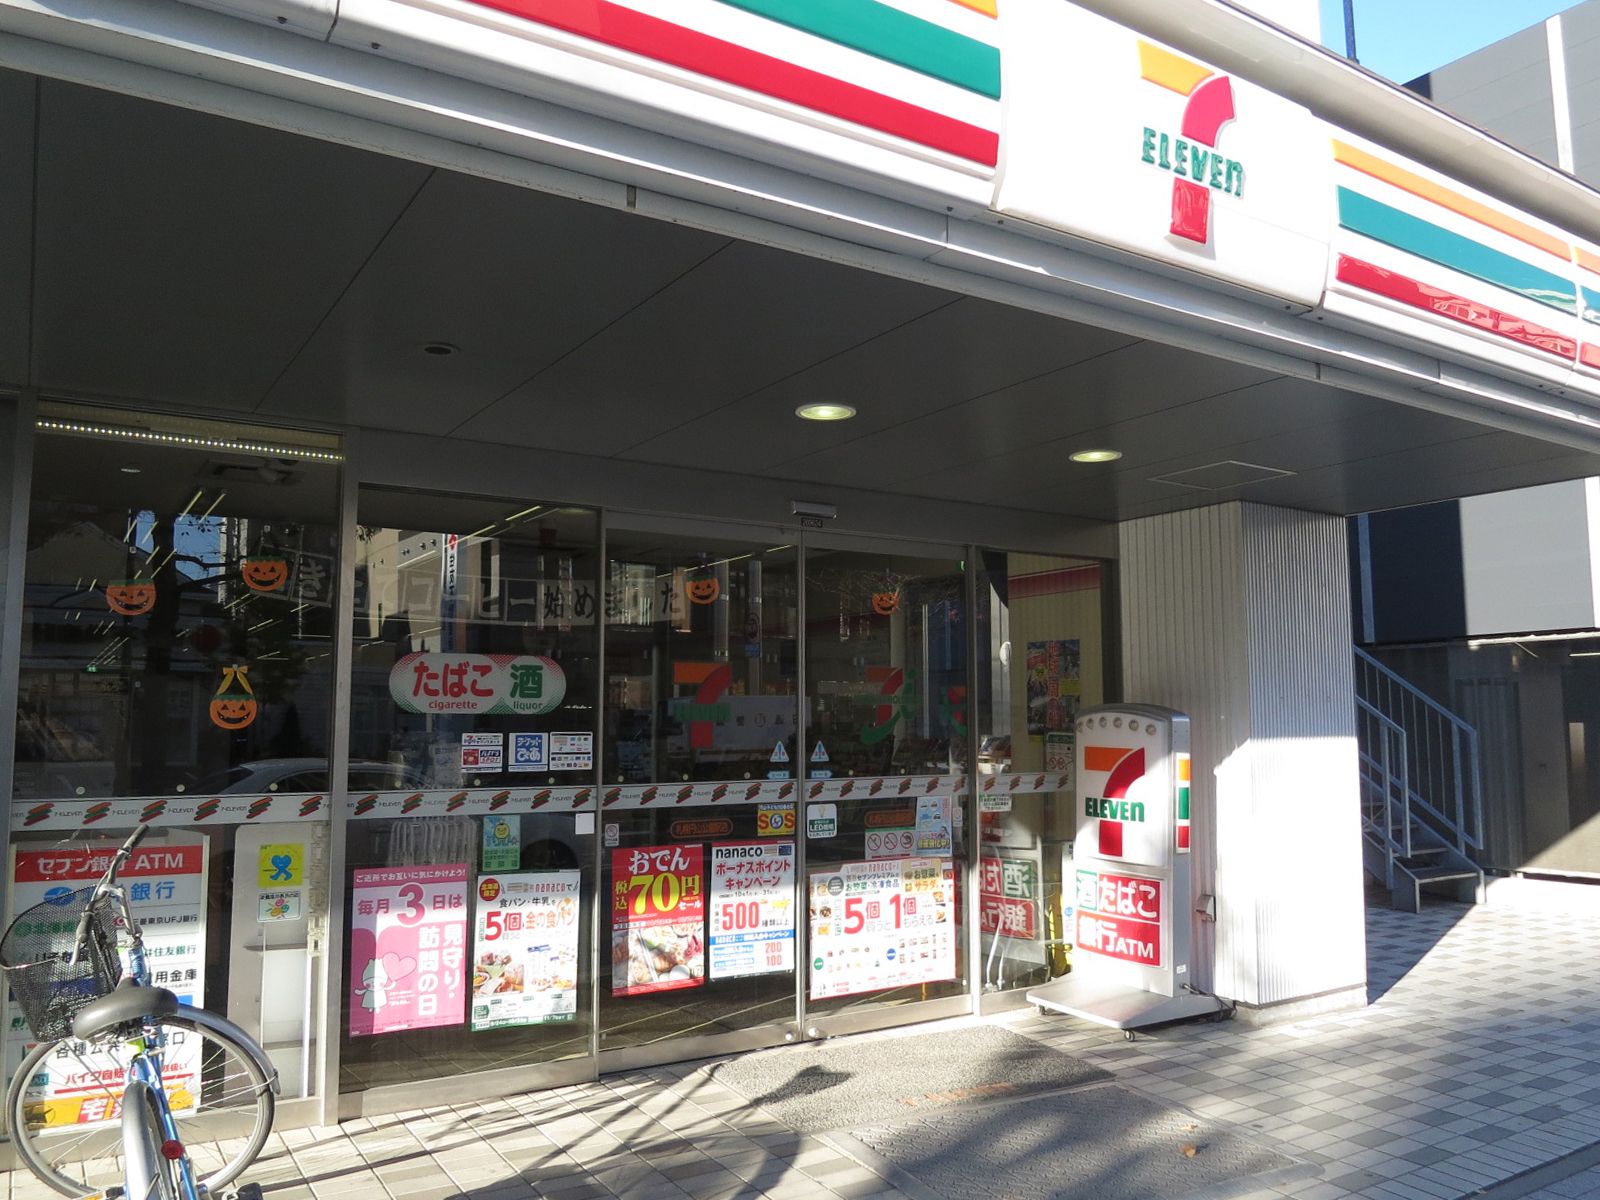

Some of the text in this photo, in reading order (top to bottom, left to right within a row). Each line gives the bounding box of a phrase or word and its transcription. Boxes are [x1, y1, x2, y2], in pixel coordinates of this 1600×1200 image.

[412, 661, 544, 699] たばこ 酒
[428, 700, 543, 711] cigarette liquor
[136, 852, 184, 869] ATM
[628, 847, 691, 875] おでん
[716, 847, 763, 859] nanaco
[716, 860, 791, 876] ボーナスポイント
[725, 875, 782, 890] キャンペーン
[615, 880, 628, 911] 税込
[678, 900, 702, 910] セール
[1077, 873, 1157, 918] 酒 たばこ
[722, 902, 760, 930] 500
[418, 926, 441, 1016] 訪問の日
